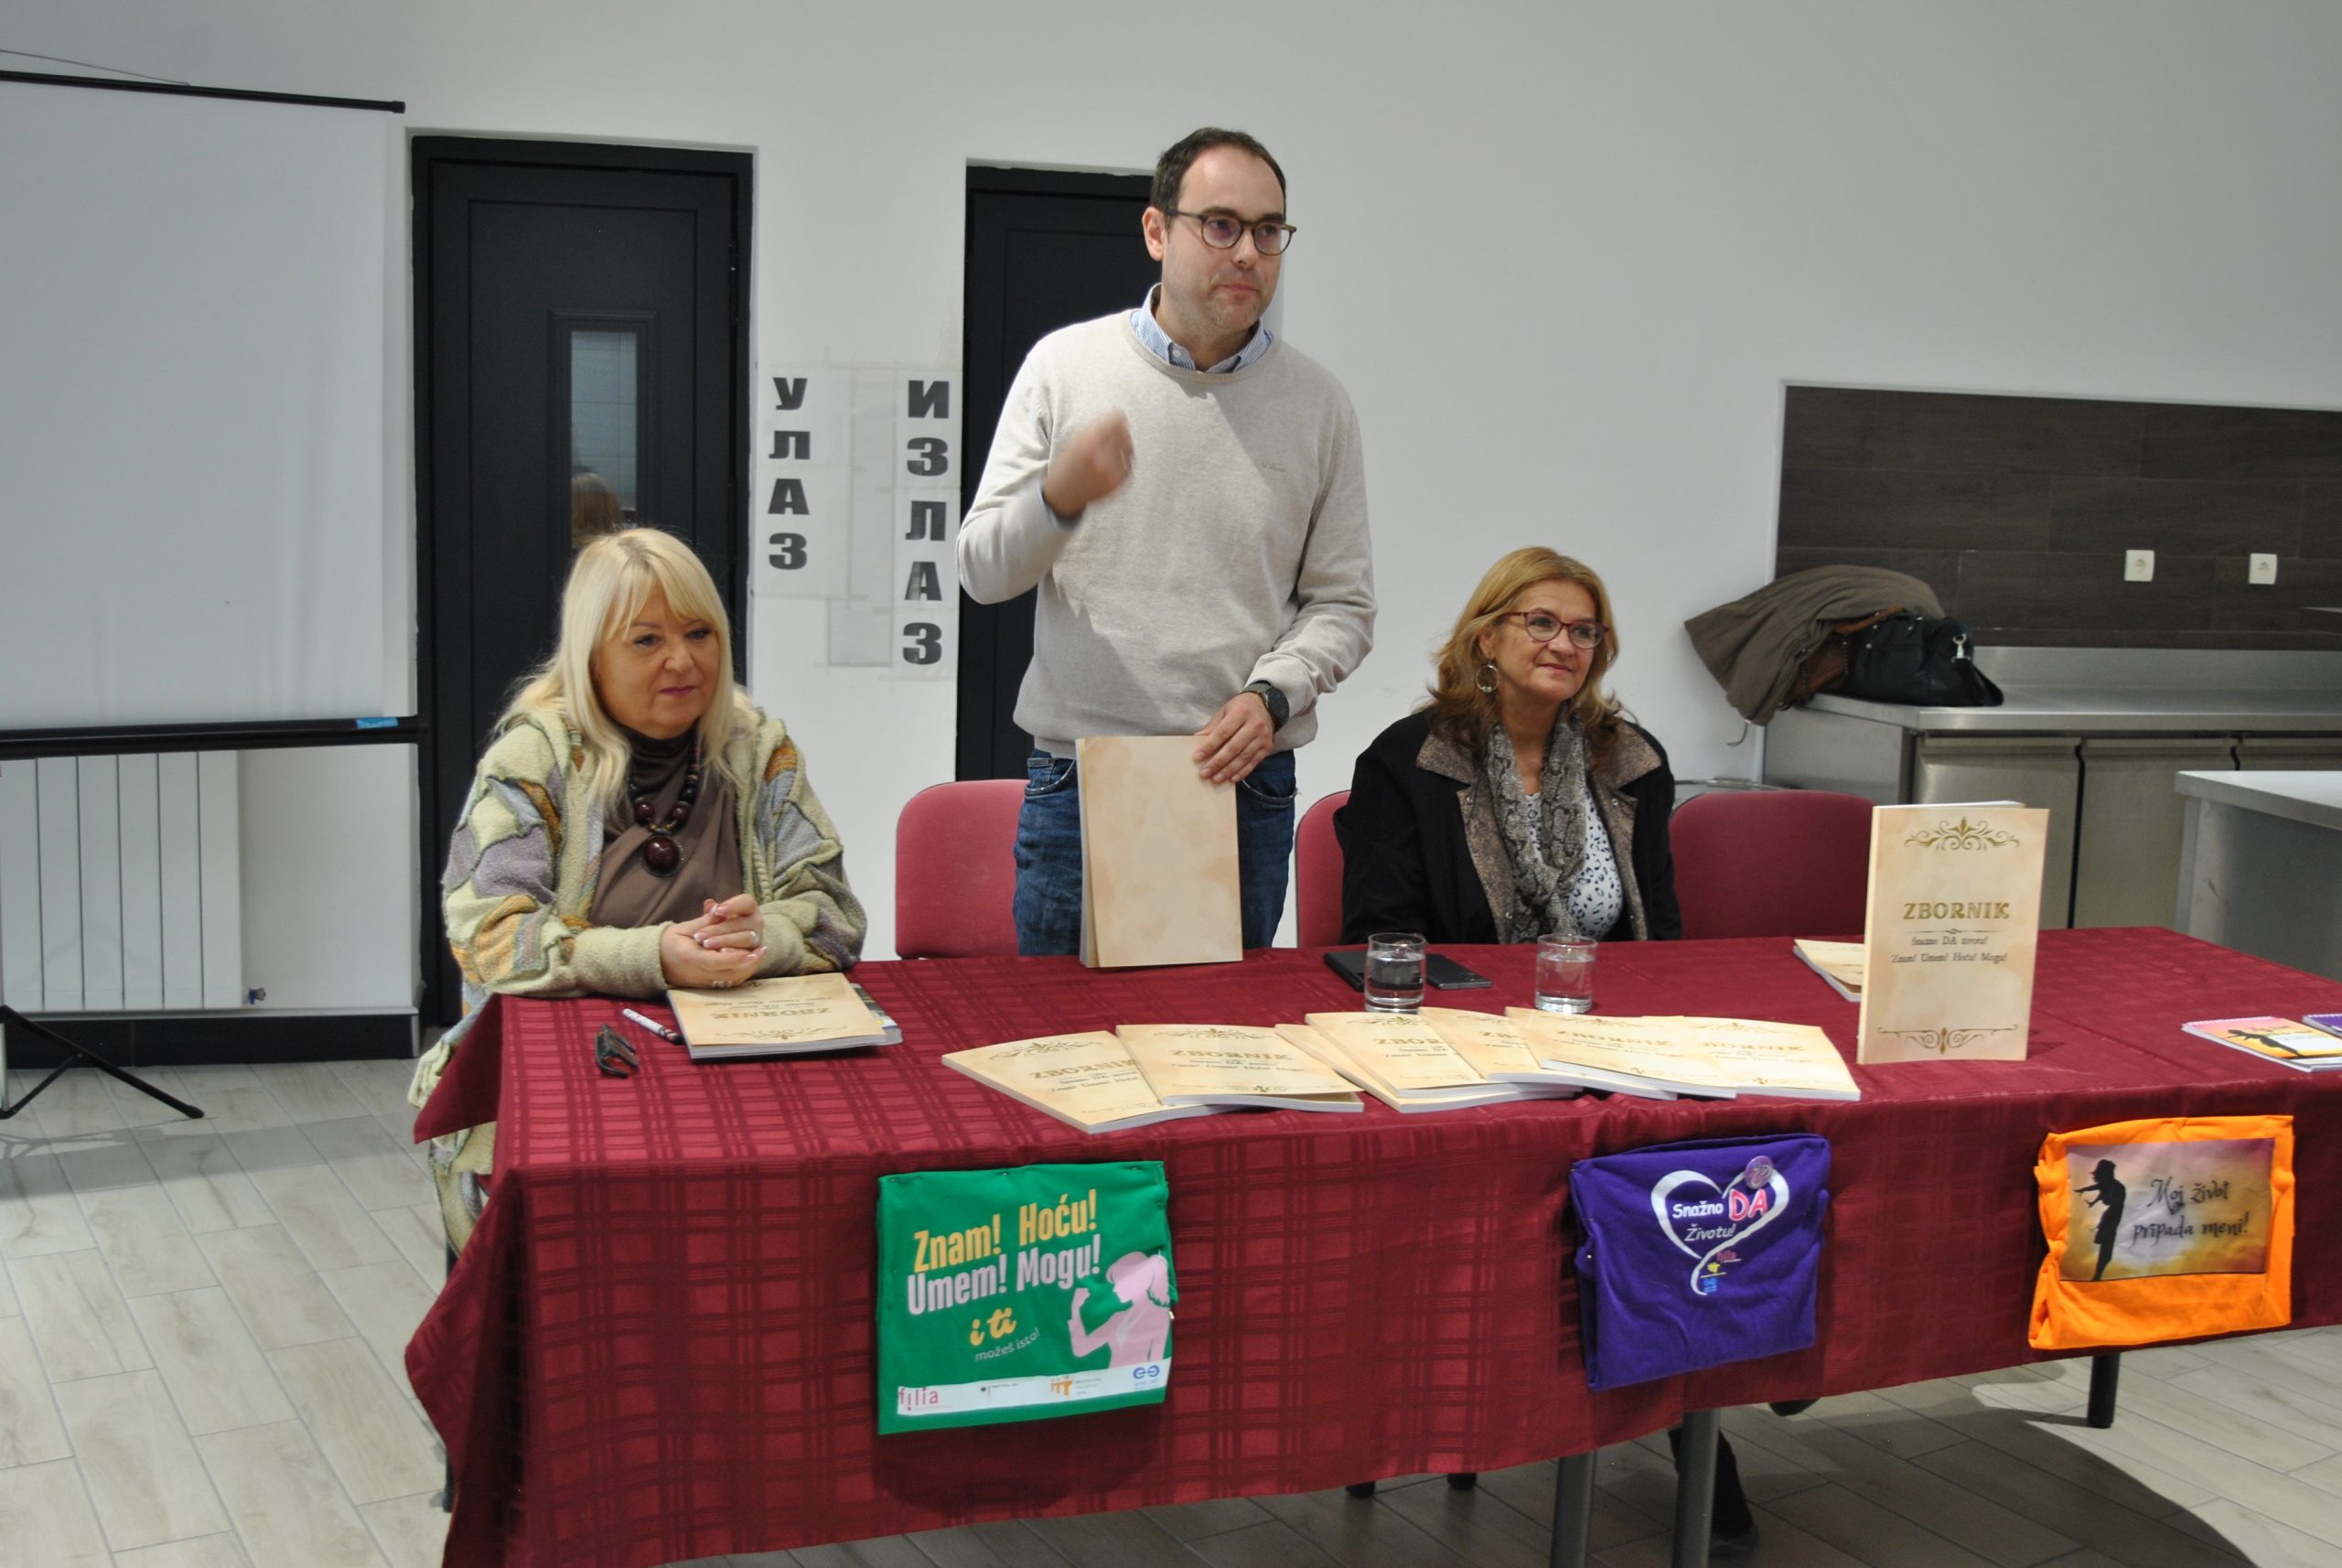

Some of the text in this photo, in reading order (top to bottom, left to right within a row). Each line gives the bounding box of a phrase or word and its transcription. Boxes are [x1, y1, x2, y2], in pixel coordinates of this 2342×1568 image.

[768, 376, 811, 571] УЛАЗ
[902, 380, 951, 665] ИЗЛАЗ
[1903, 902, 2010, 920] ZBORNIK
[1941, 936, 1957, 945] DA
[1672, 1187, 1767, 1221] Snažno DA
[914, 1188, 1097, 1273] Znam! Hoću!
[1684, 1223, 1736, 1242] Životu!
[2202, 1211, 2250, 1237] meni!
[907, 1233, 1101, 1316] Umem! Mogu!
[974, 1326, 1041, 1362] možeš isto!
